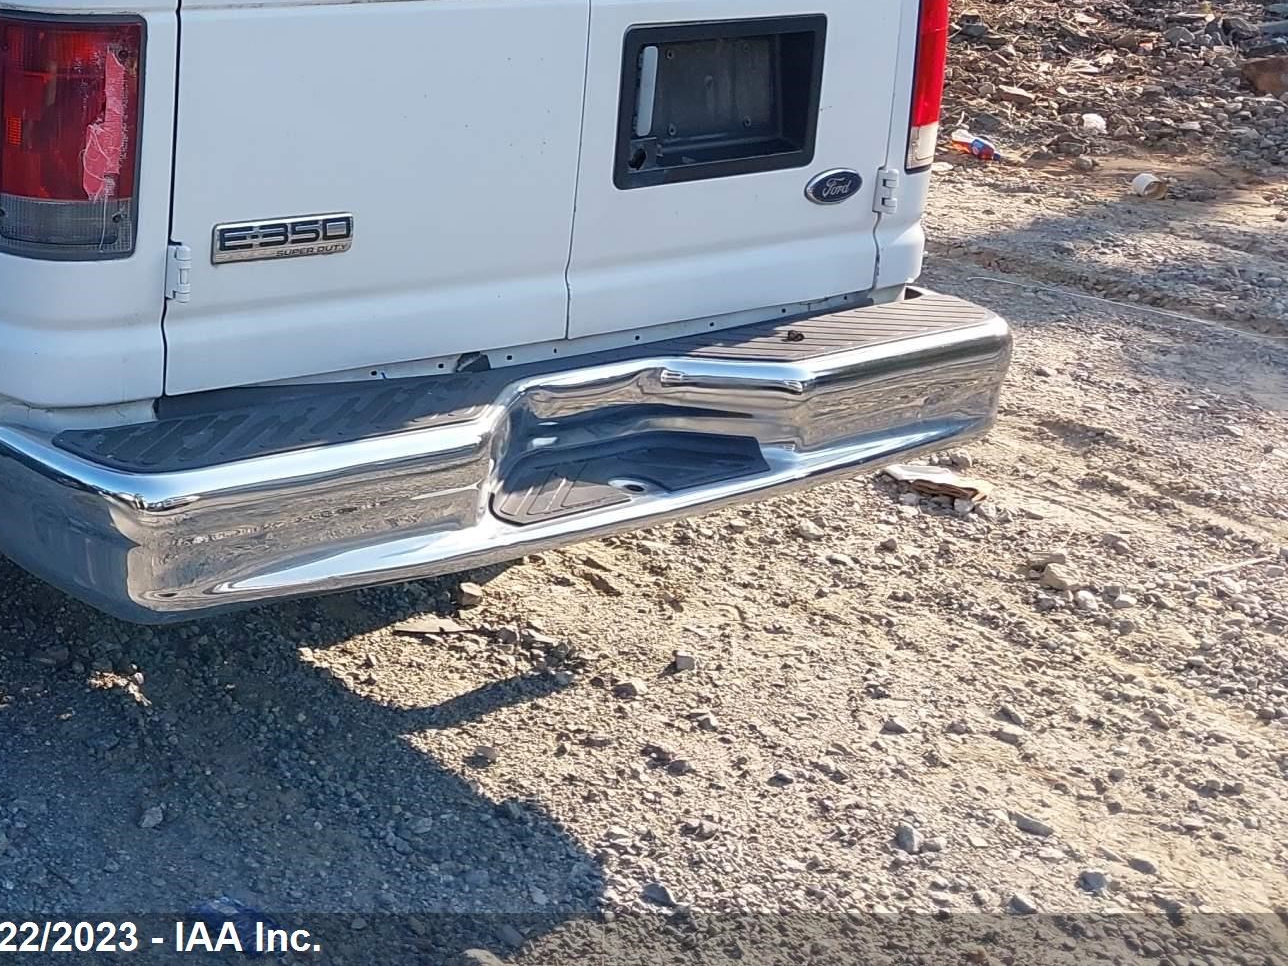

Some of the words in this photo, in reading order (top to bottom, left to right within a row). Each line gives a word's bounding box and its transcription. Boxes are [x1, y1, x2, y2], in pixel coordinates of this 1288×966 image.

[822, 177, 852, 198] Ford
[275, 247, 314, 257] SUPER
[316, 244, 346, 253] DUTY
